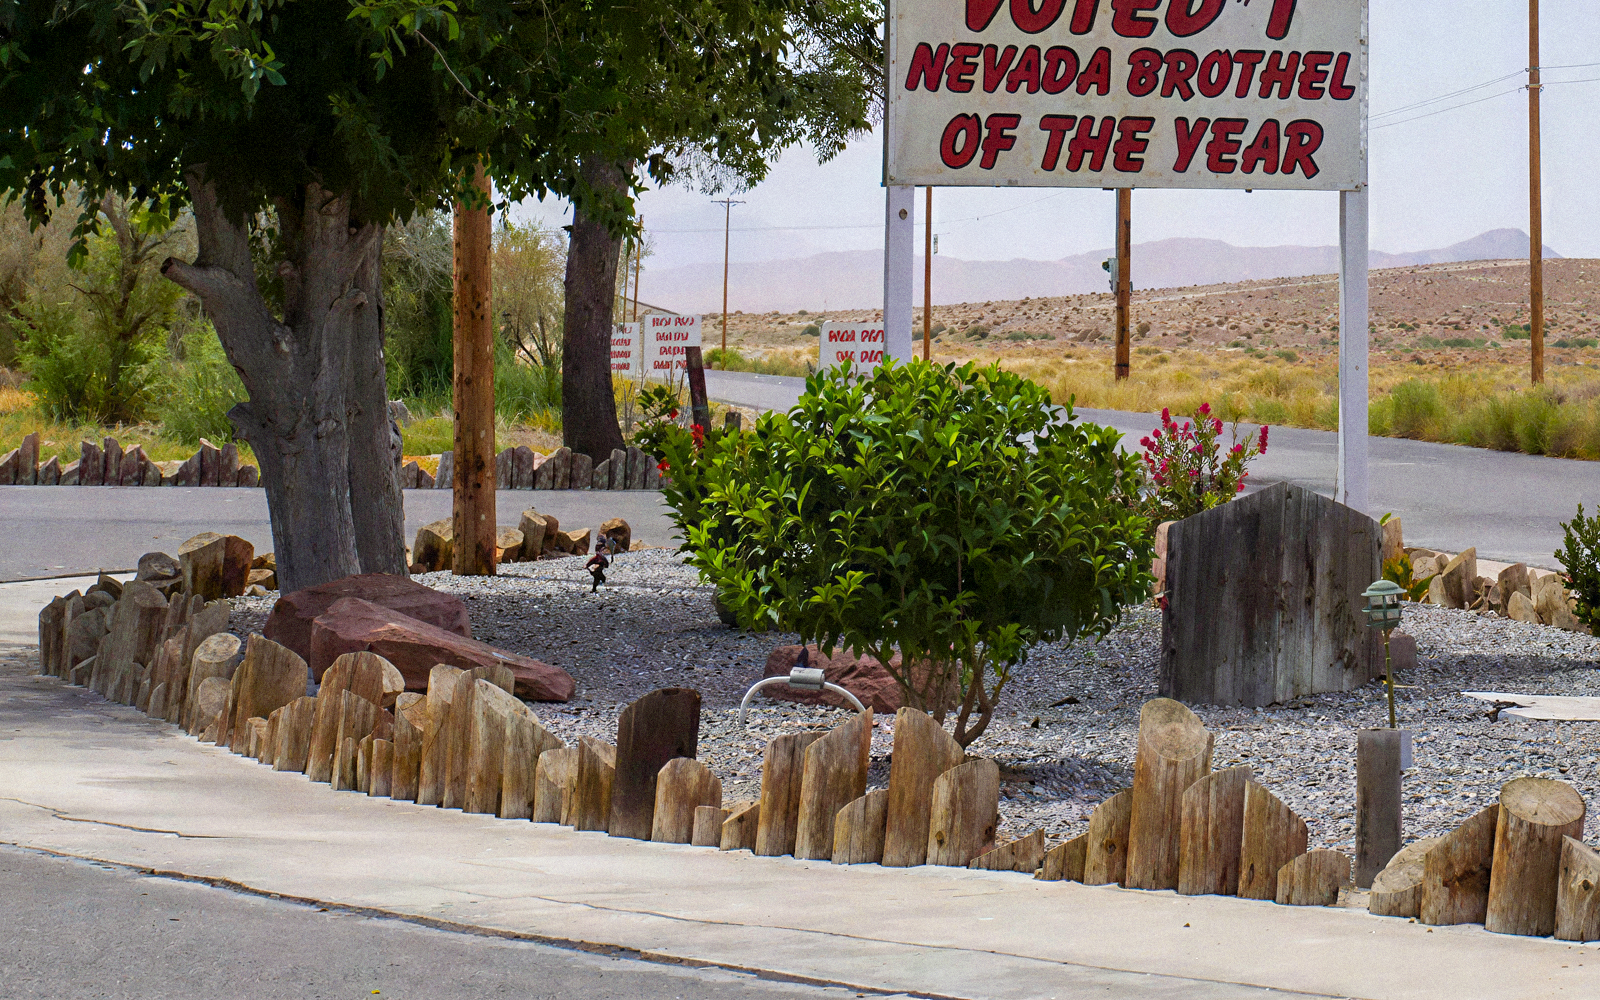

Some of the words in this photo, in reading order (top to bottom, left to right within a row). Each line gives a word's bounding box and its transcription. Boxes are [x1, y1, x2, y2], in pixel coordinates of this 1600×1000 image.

[905, 42, 1111, 97] NEVADA
[1126, 47, 1357, 101] BROTHEL
[940, 113, 1022, 170] OF
[1039, 114, 1156, 173] THE
[1172, 116, 1324, 179] YEAR
